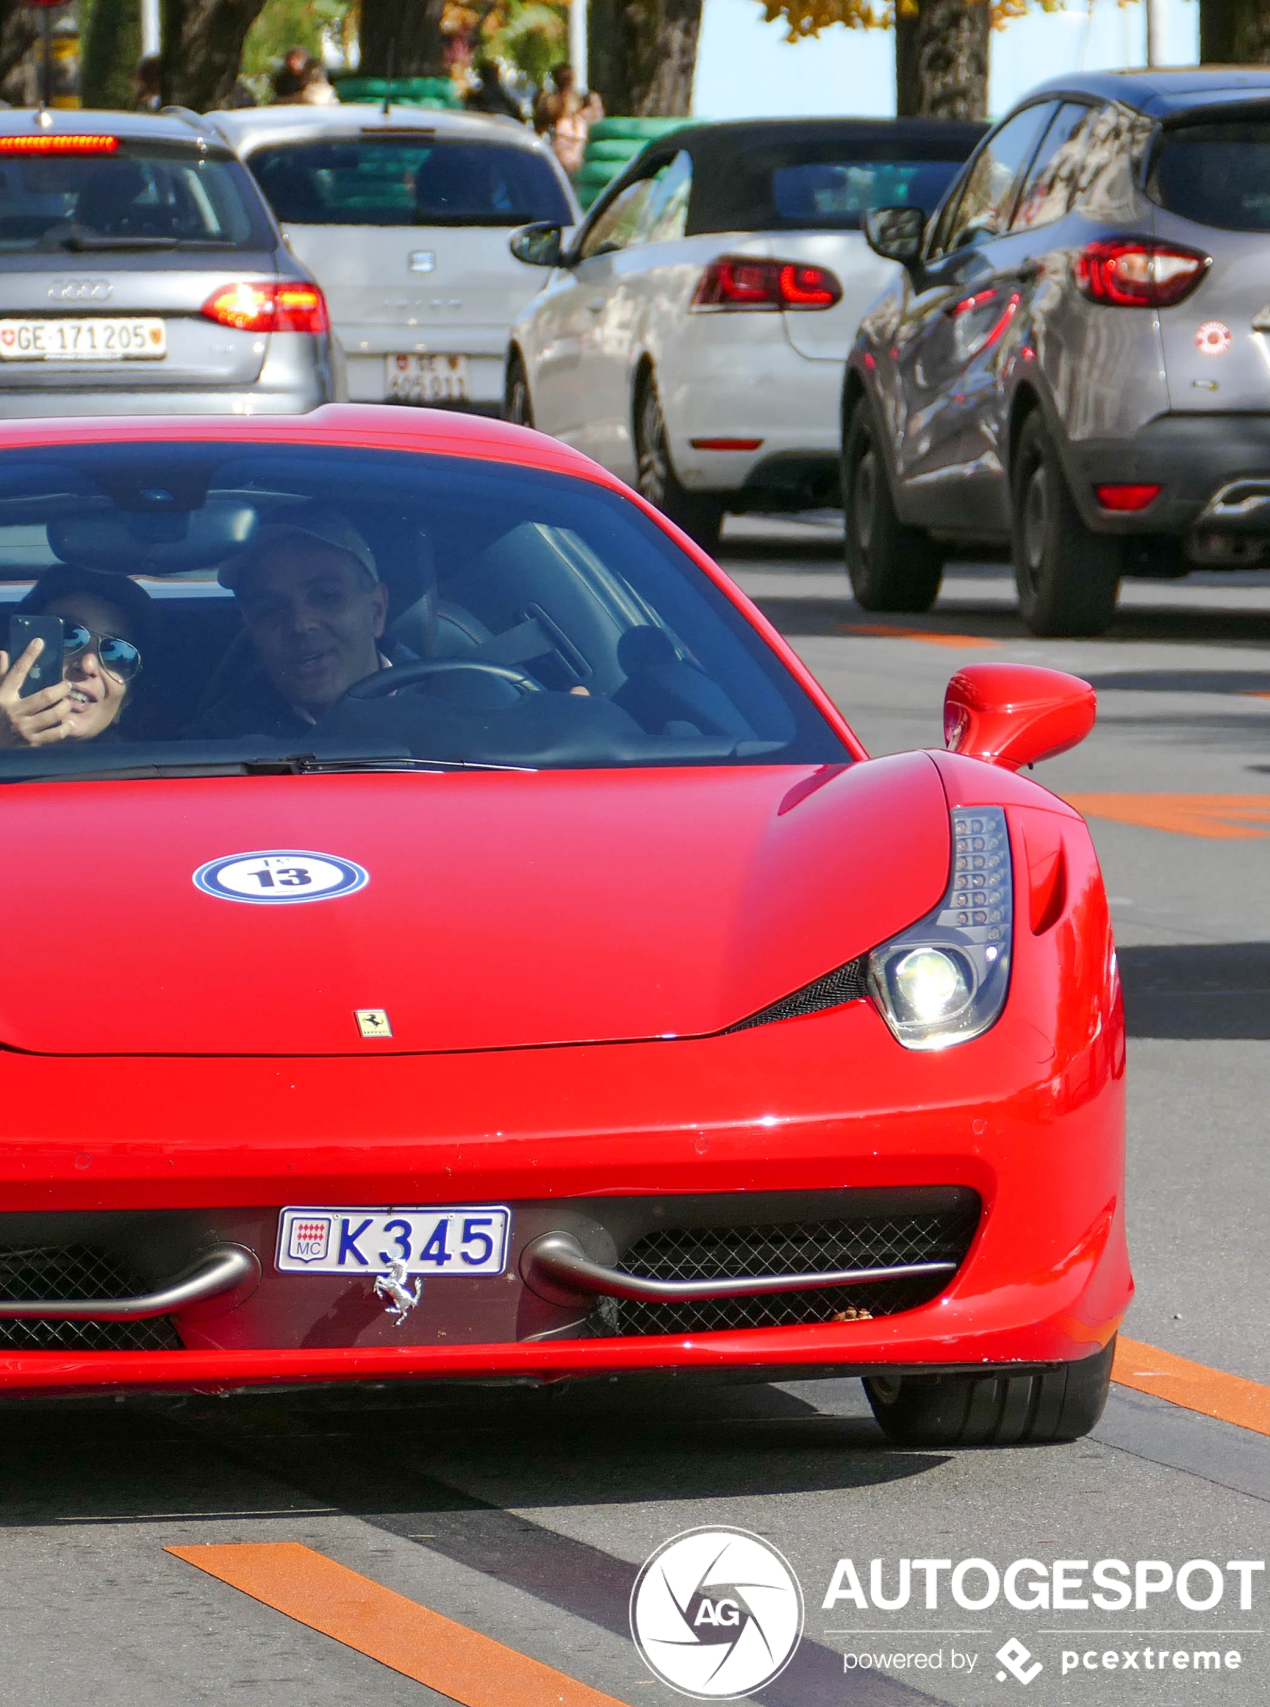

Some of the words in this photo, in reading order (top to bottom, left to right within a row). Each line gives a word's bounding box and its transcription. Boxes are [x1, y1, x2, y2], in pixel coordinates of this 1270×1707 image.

[247, 868, 312, 888] 13
[297, 1242, 321, 1255] MC
[338, 1218, 494, 1266] K345
